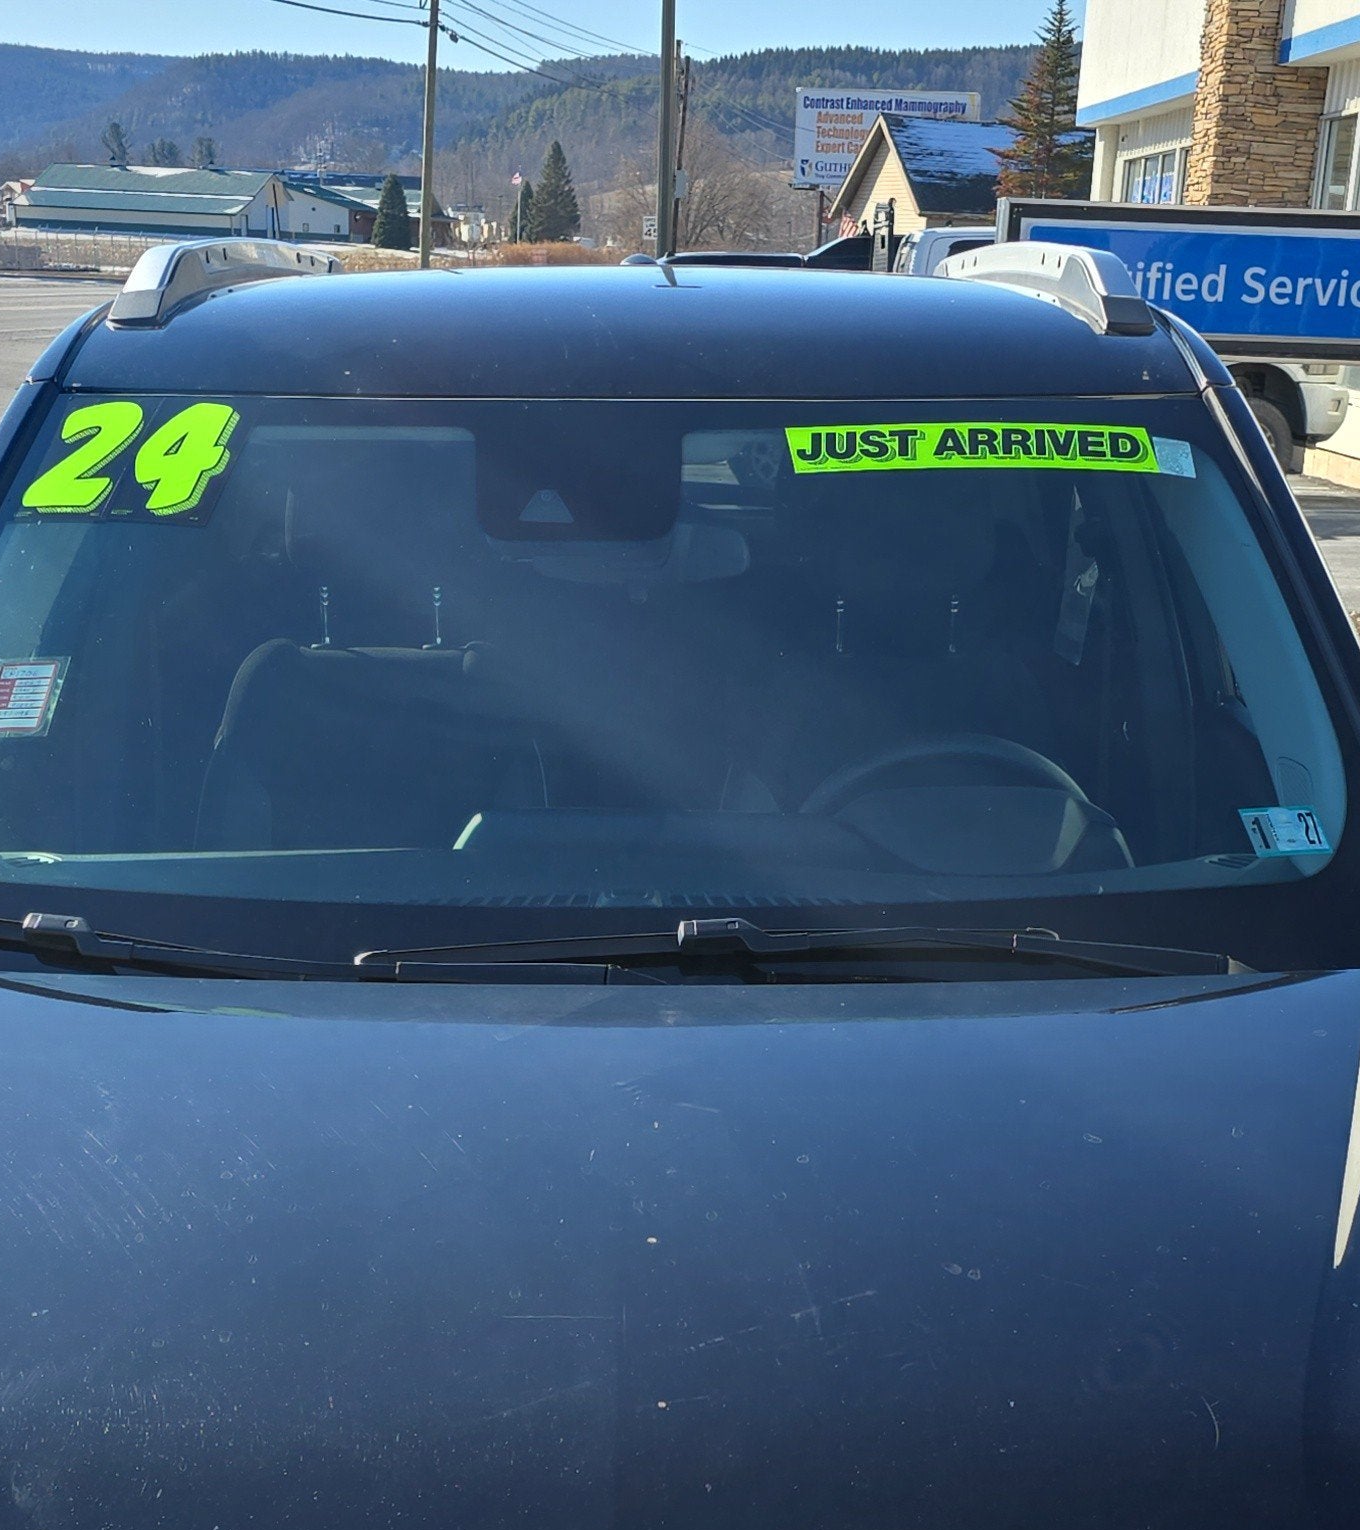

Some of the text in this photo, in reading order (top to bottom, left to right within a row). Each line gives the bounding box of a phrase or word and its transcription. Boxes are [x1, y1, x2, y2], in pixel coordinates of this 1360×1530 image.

[803, 96, 967, 115] Contrast Enhanced Mammography
[816, 111, 863, 124] Advanced
[816, 141, 845, 153] Expert
[815, 161, 851, 172] GUTH
[1125, 261, 1227, 303] ified
[22, 401, 238, 514] 24
[796, 427, 1147, 463] JUST ARRIVED
[1296, 812, 1323, 845] 27
